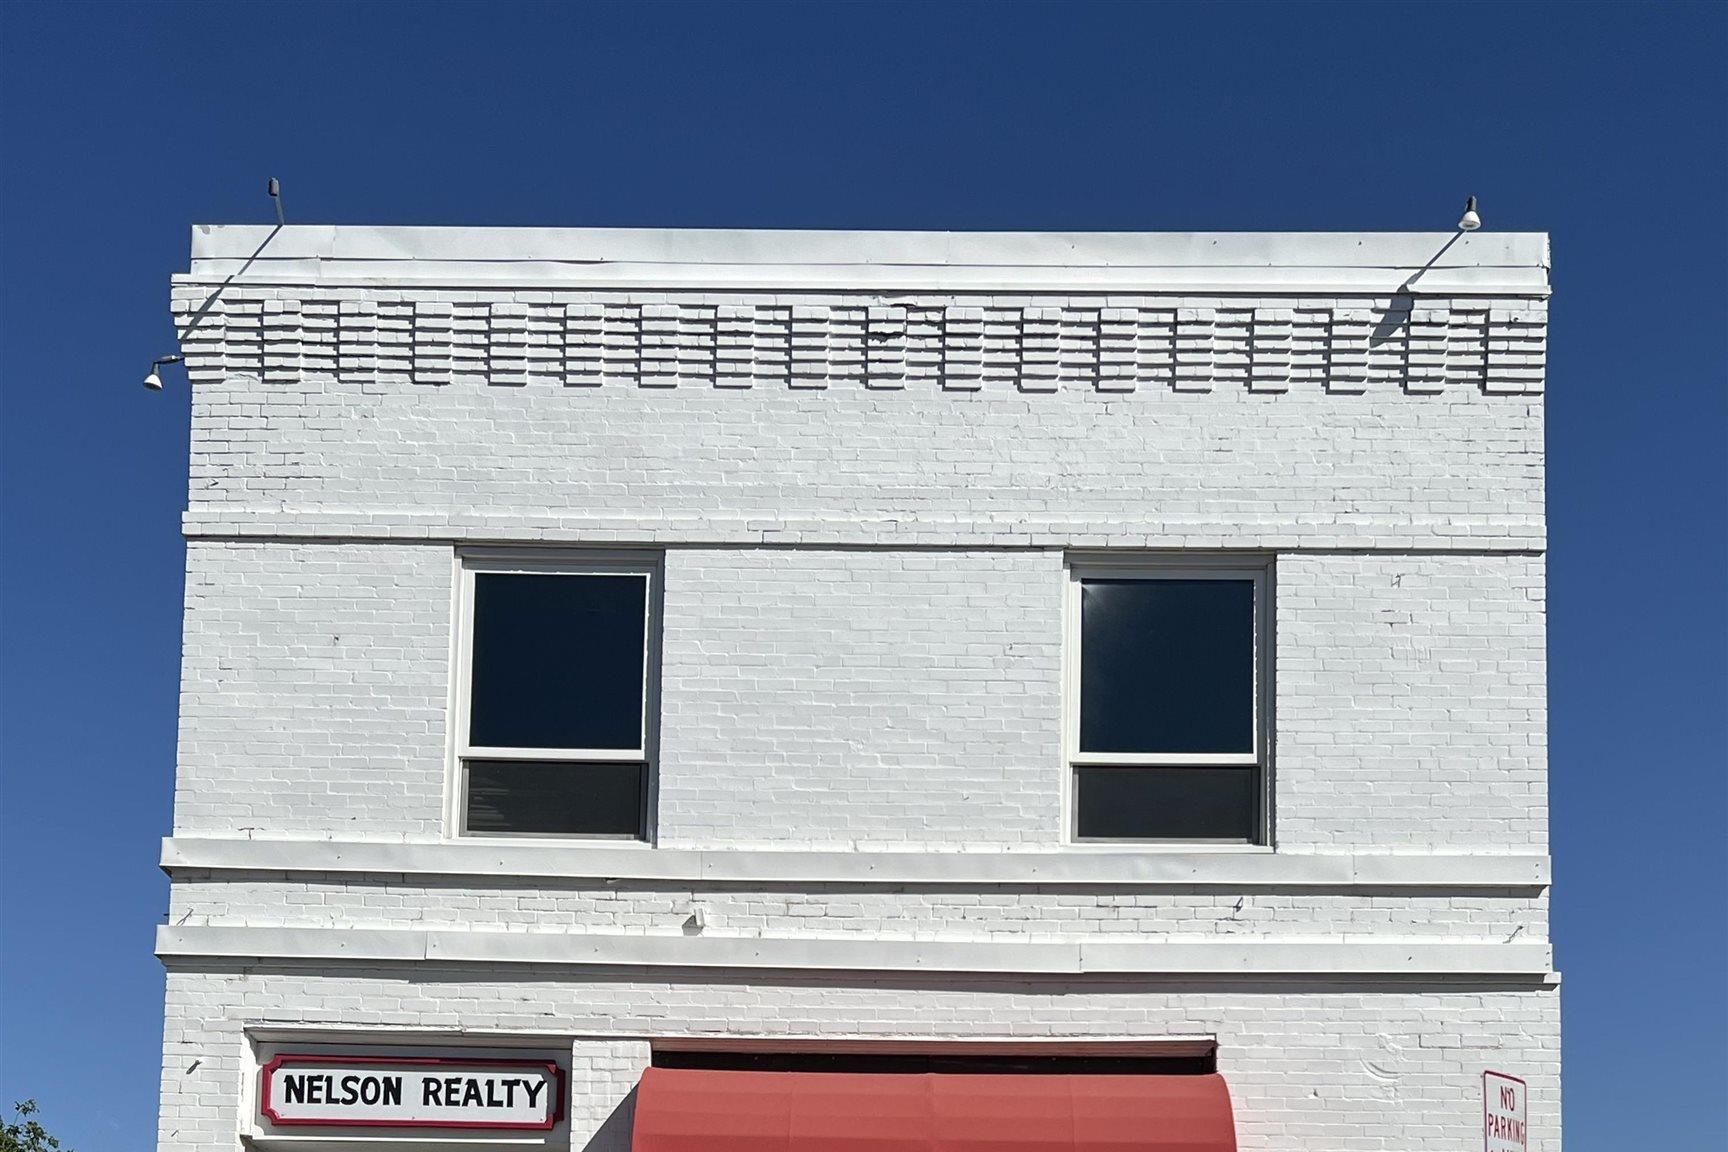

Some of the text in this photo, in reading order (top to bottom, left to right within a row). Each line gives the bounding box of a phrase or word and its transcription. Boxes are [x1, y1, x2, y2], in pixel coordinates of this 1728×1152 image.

[284, 1074, 546, 1108] NELSON REALTY
[1500, 1085, 1515, 1111] NO
[1488, 1113, 1525, 1145] PARKING
